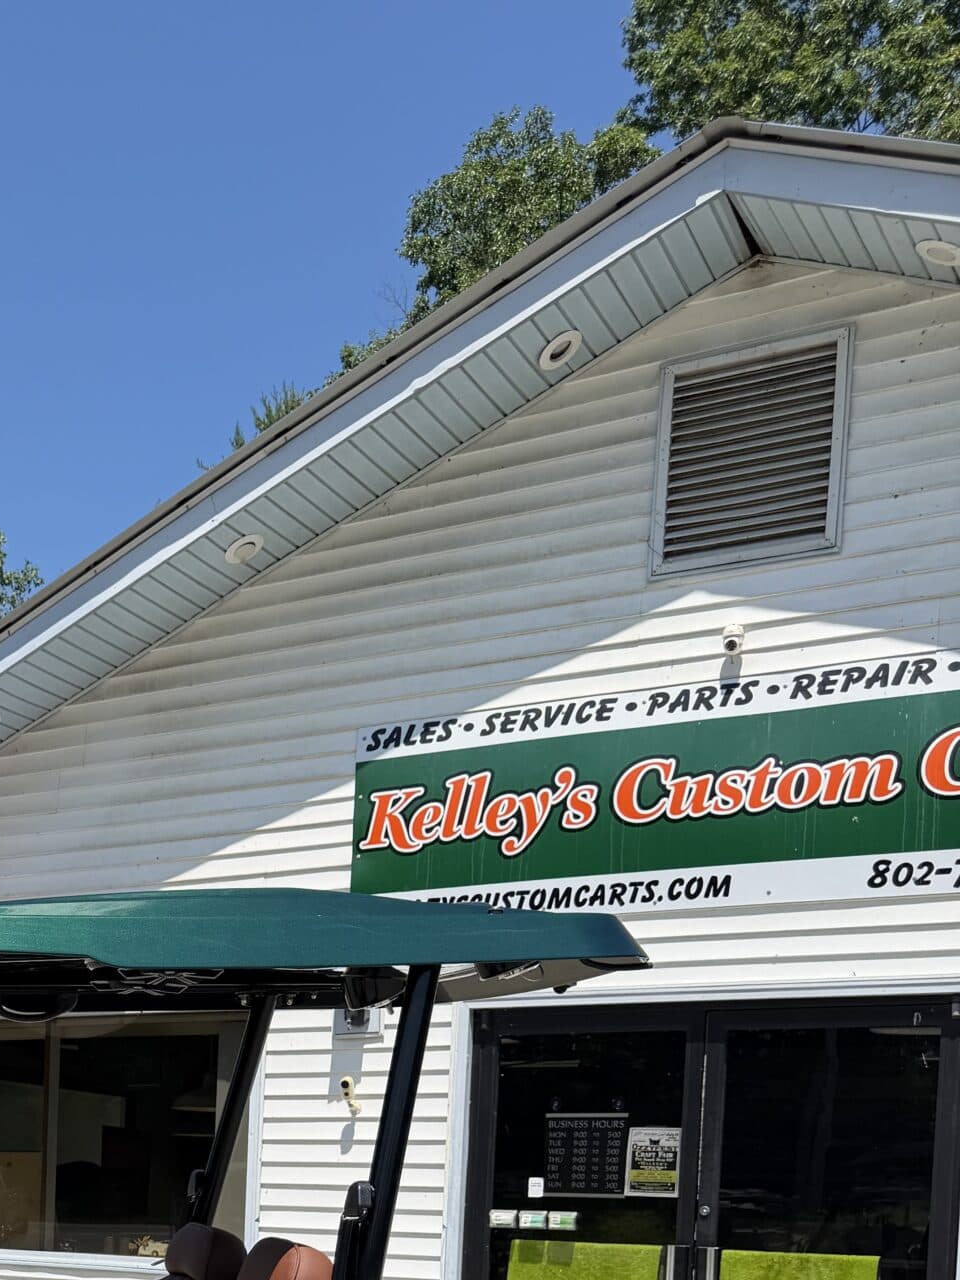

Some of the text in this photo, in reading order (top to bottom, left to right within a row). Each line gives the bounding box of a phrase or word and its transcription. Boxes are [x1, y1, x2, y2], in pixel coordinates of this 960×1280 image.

[366, 658, 937, 752] SALES SERVICE PARTS REPAIR
[359, 766, 598, 857] Kelley's
[614, 753, 903, 824] Custom
[415, 859, 960, 912] USTOMCARTS.COM 802-
[548, 1120, 625, 1128] BUSINESS HOURS
